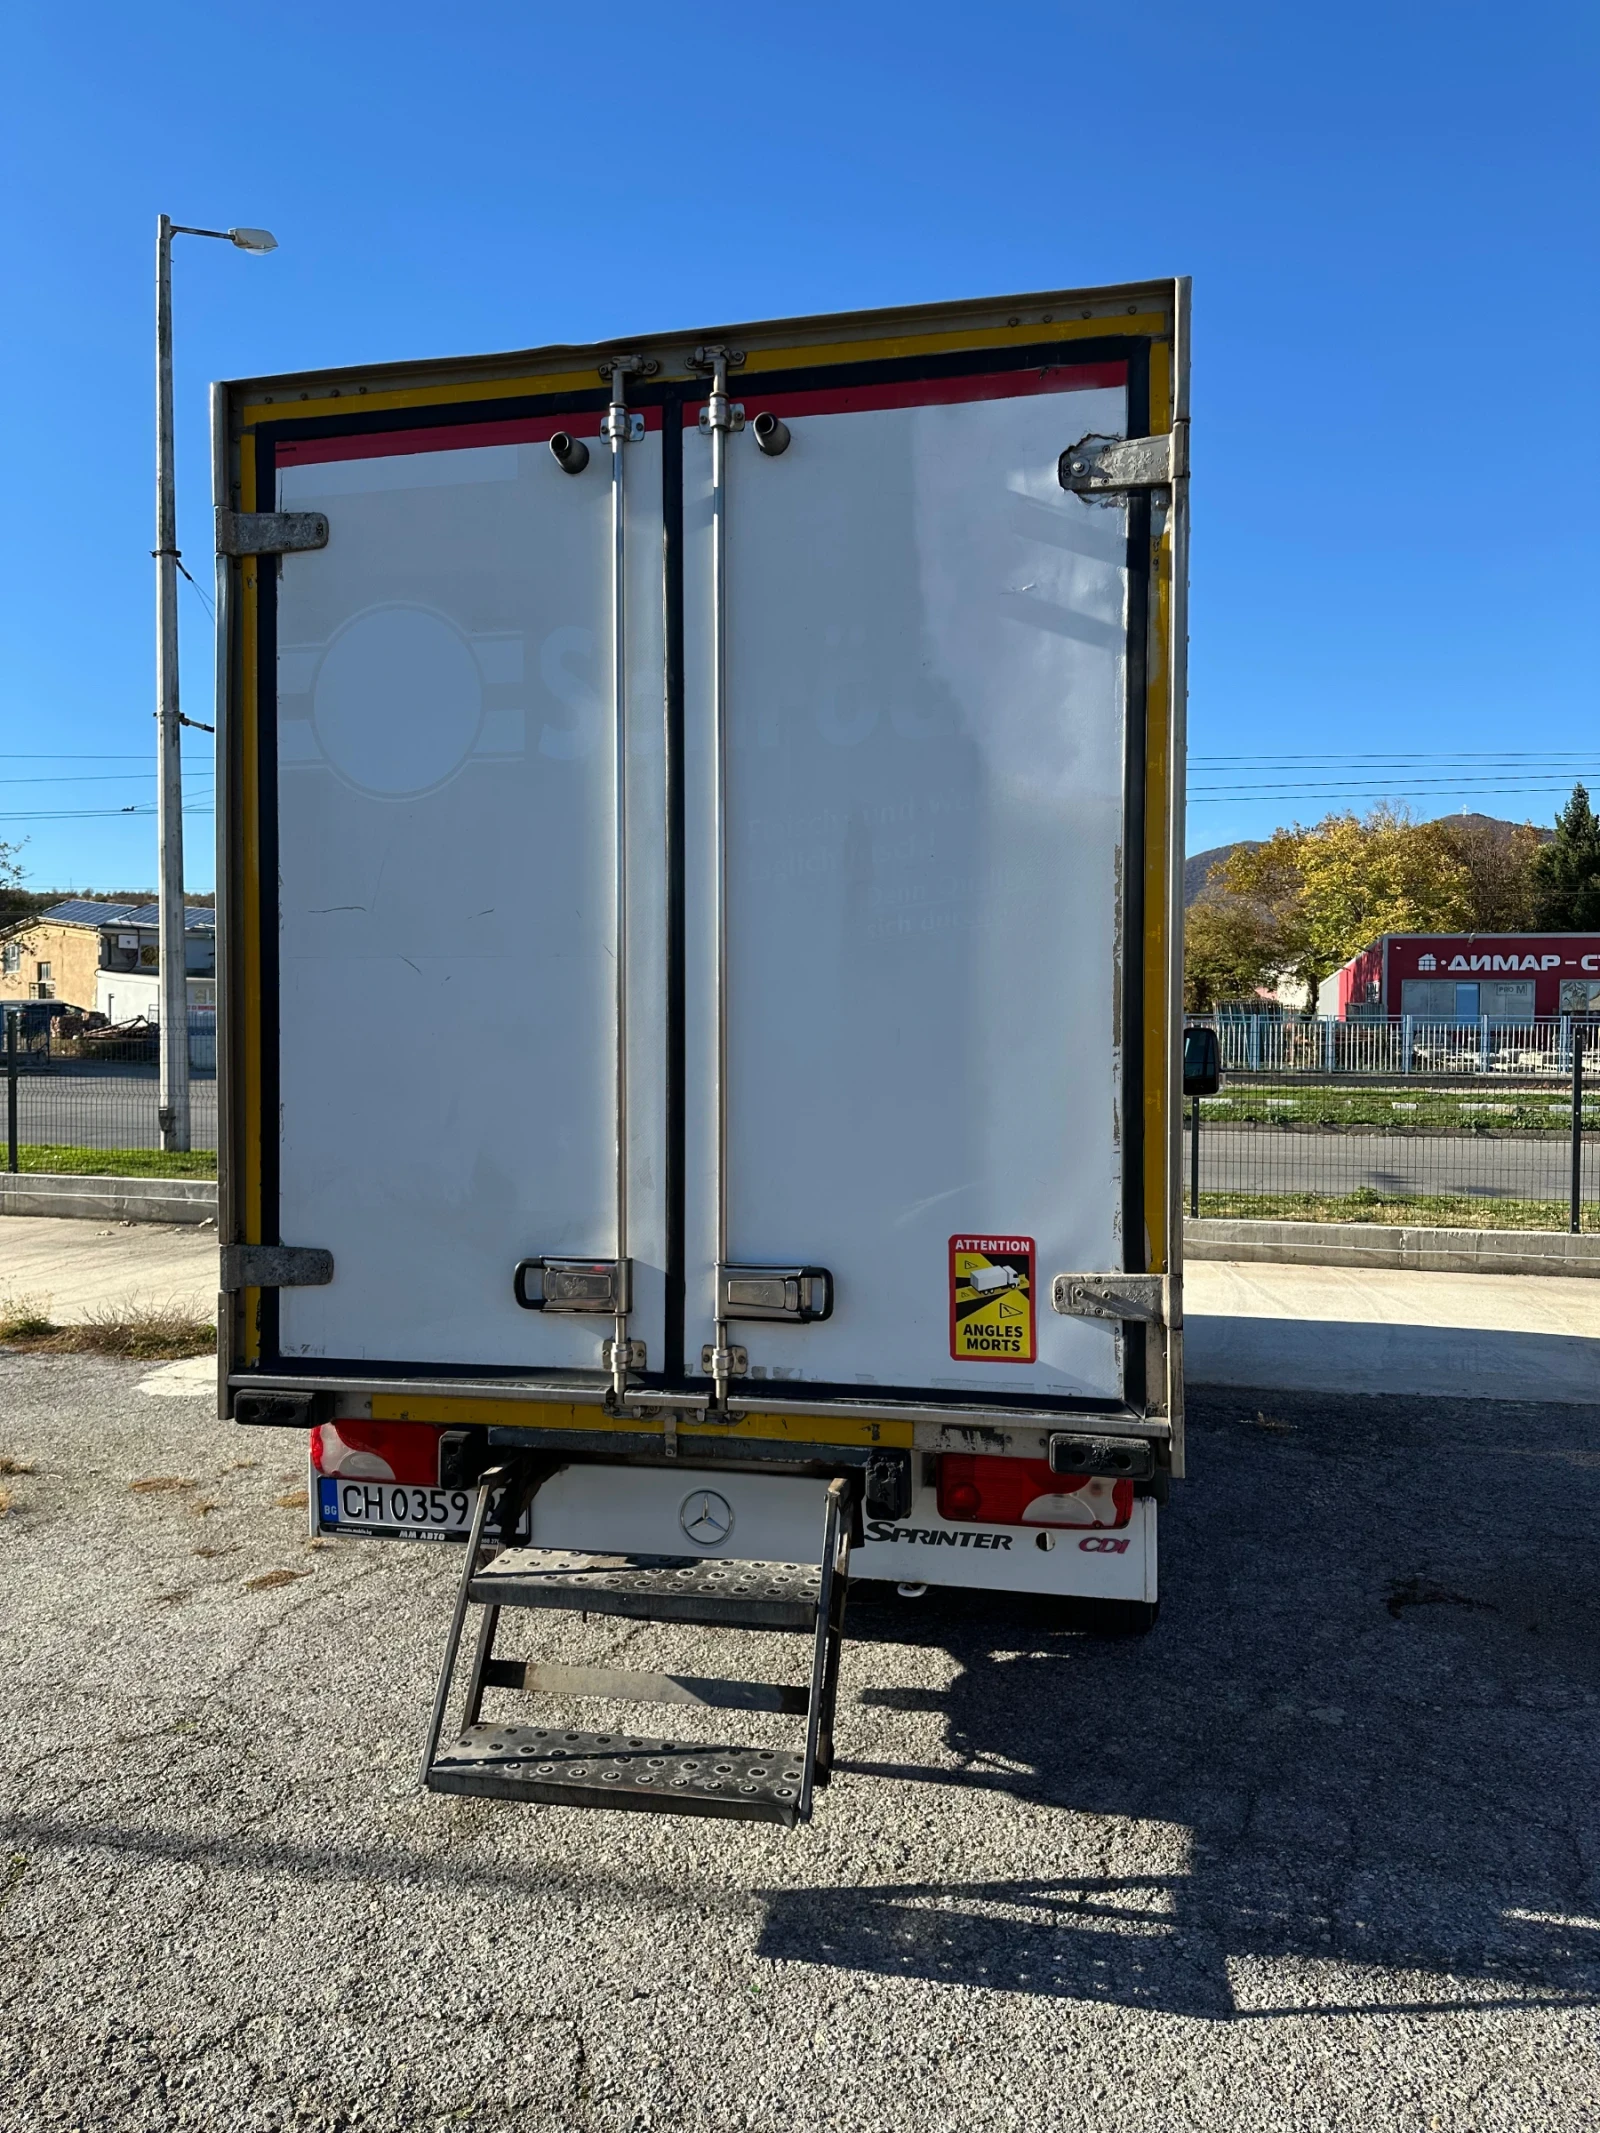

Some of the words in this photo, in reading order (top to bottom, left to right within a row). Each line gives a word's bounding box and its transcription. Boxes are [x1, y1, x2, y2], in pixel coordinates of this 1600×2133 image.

[955, 1239, 1030, 1252] ATTENTION
[963, 1324, 1023, 1338] ANGLES
[966, 1338, 1021, 1352] MORTS
[324, 1504, 337, 1516] BG
[864, 1521, 1014, 1552] SPRINTER
[1078, 1536, 1131, 1555] CDI
